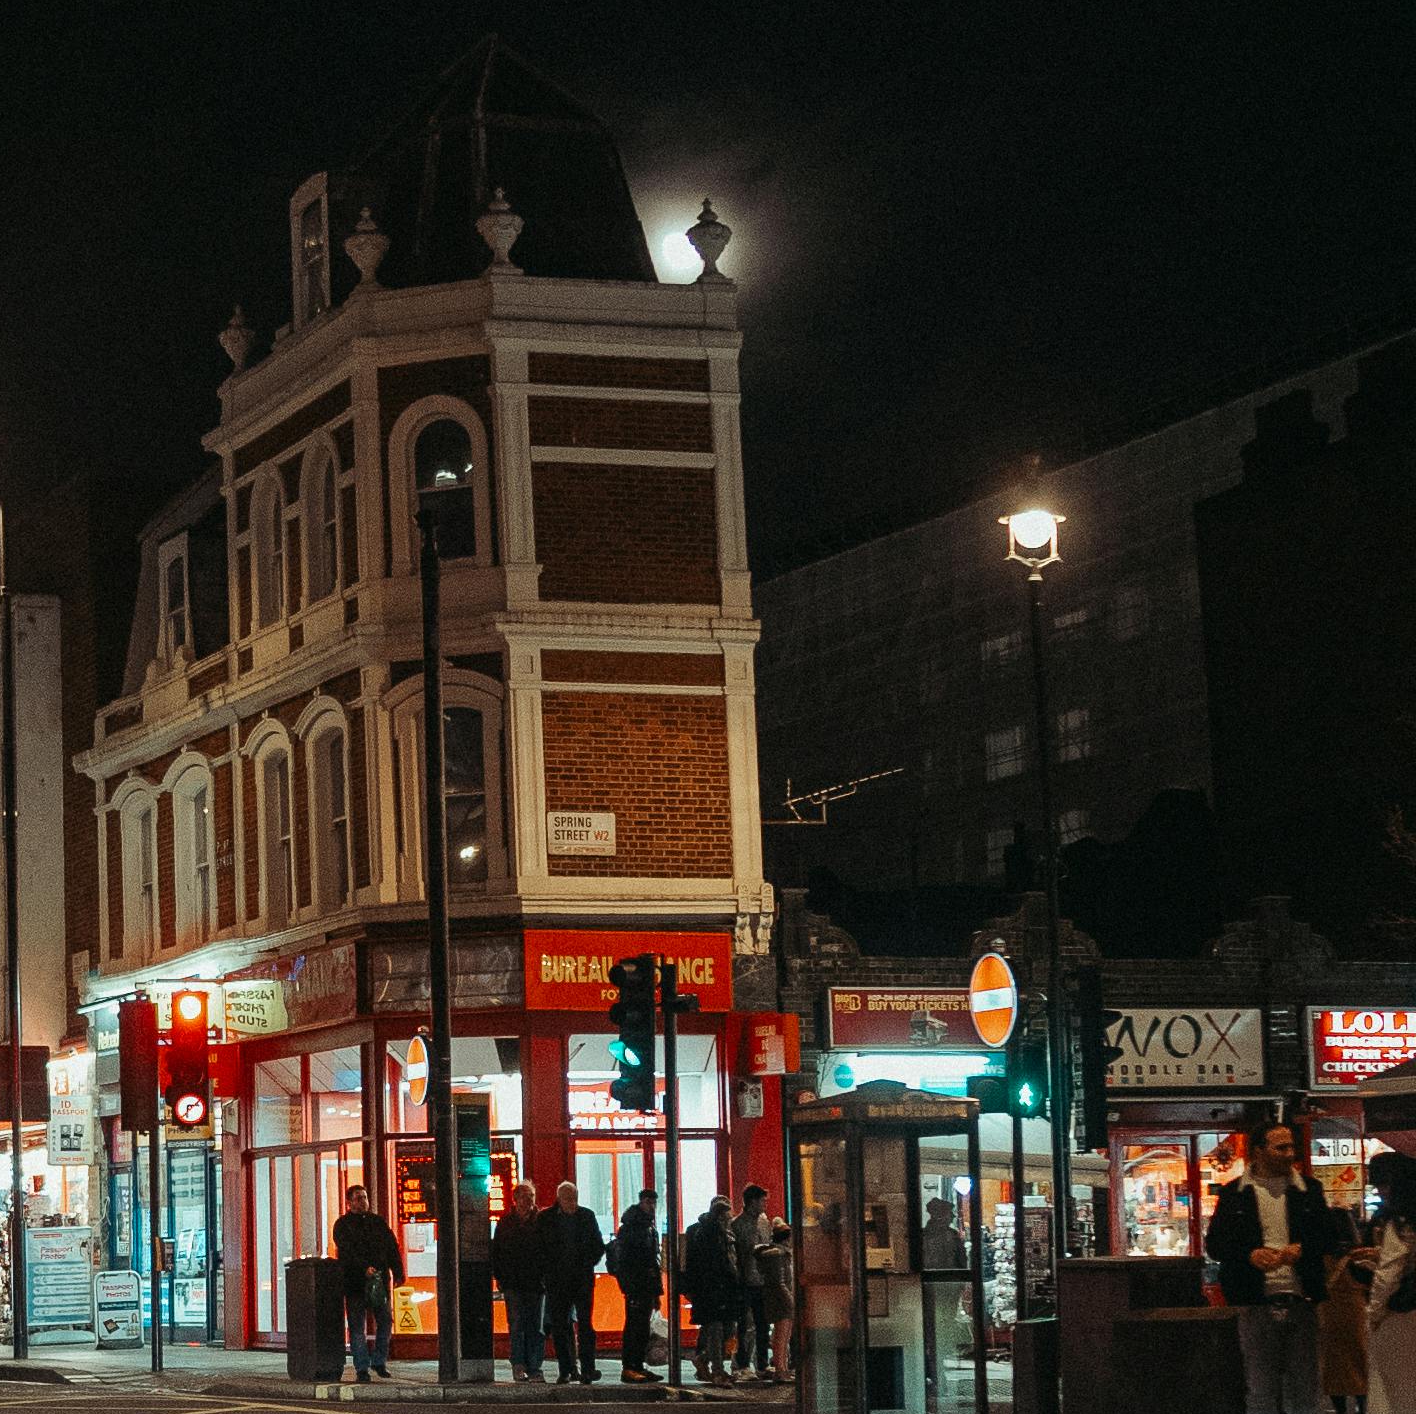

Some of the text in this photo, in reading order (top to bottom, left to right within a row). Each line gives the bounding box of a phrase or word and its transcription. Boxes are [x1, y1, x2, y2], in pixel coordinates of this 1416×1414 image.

[554, 816, 592, 828] SPRING
[554, 829, 609, 841] STREET W2
[868, 1001, 888, 1011] BUY
[890, 1001, 917, 1011] YOUR
[919, 1001, 960, 1011] TICKETS
[1197, 1064, 1235, 1075] BAR
[61, 1100, 72, 1109] ID
[40, 1246, 73, 1256] Passport
